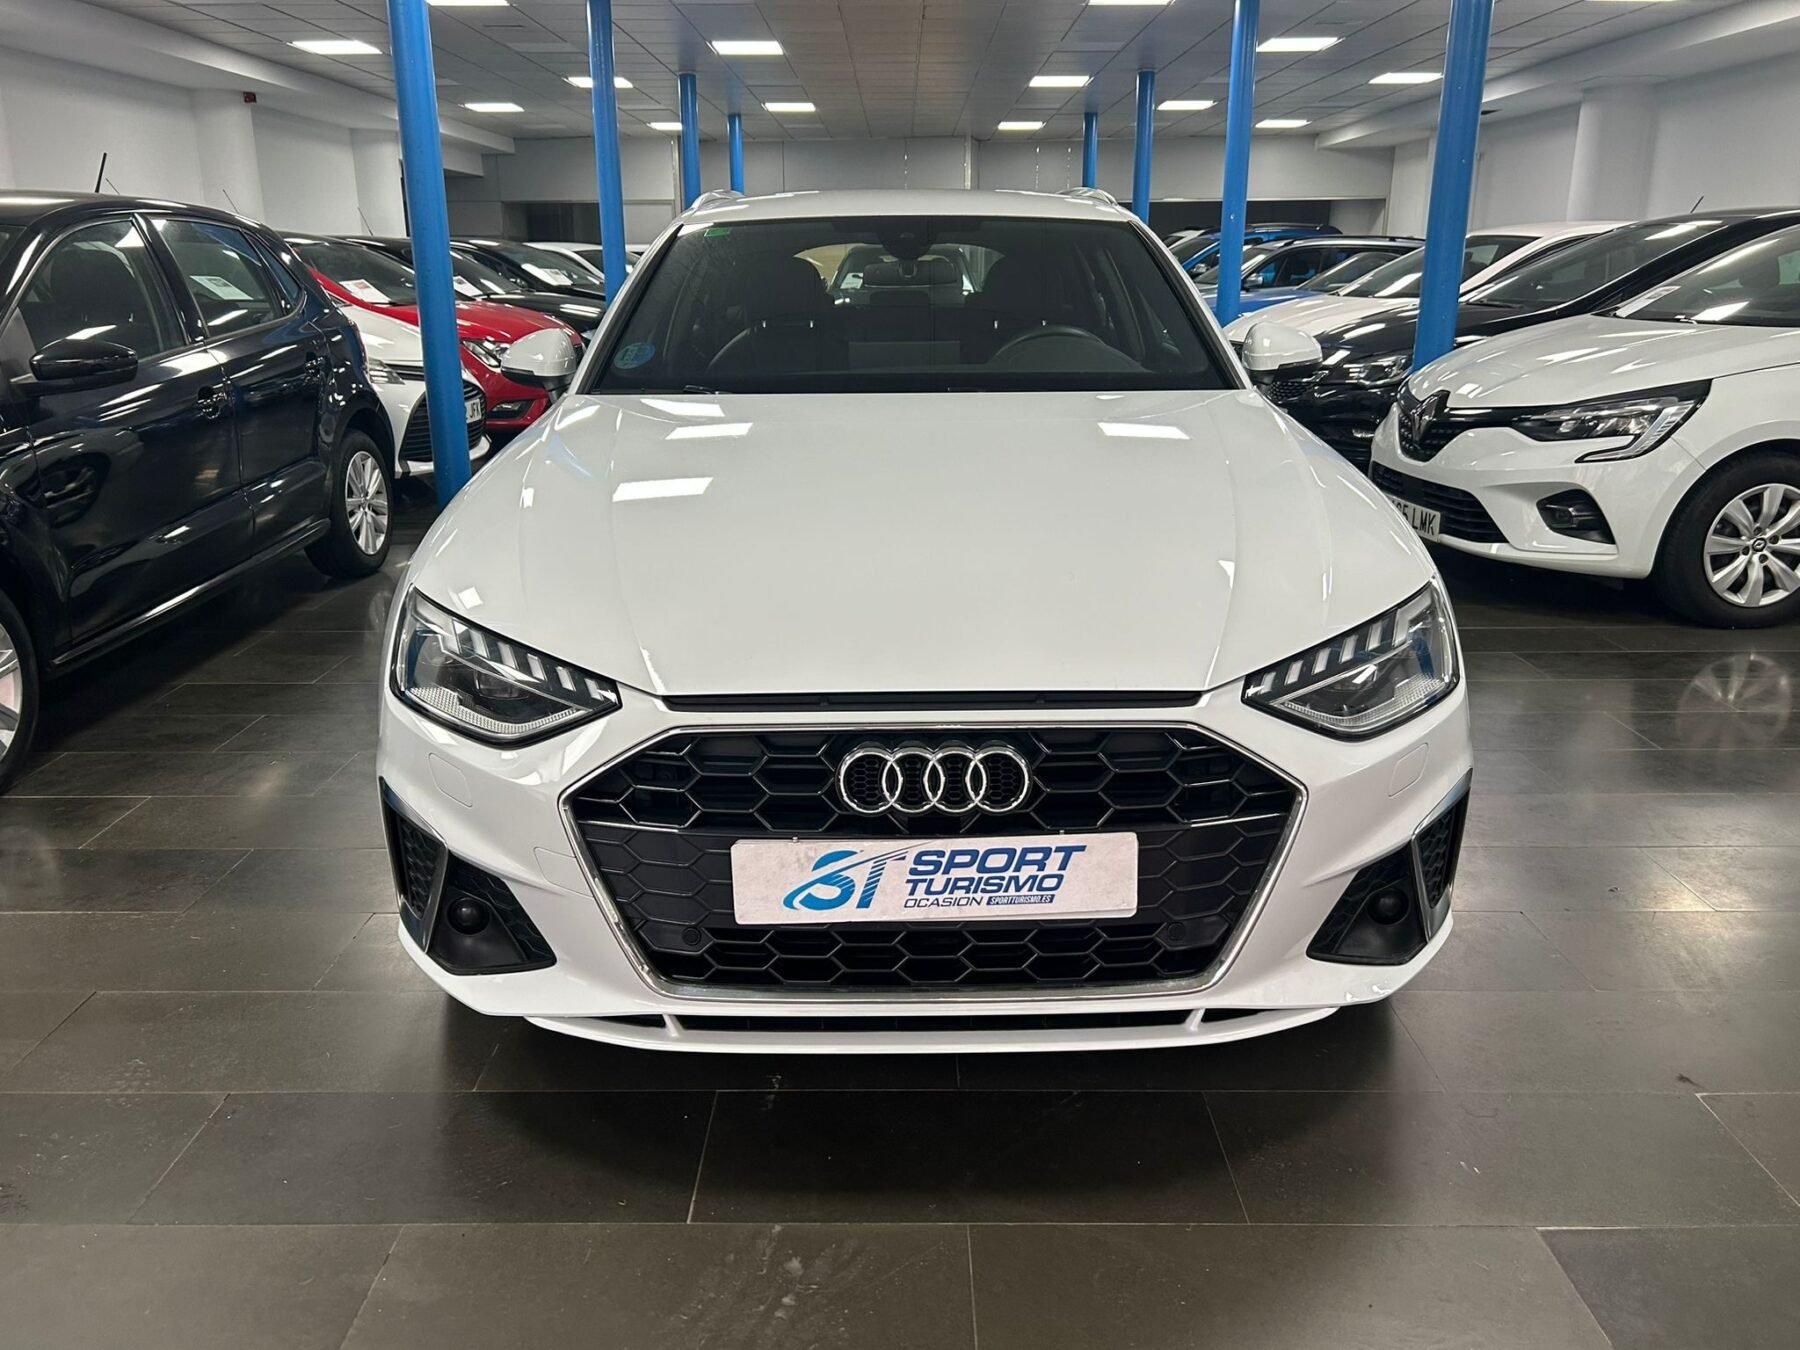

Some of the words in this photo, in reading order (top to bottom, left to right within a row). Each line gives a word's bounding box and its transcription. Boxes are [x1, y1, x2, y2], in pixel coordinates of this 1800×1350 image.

[1412, 507, 1436, 535] LMK
[909, 844, 1087, 876] SPORT
[904, 873, 1066, 897] TURISMO
[904, 896, 984, 909] OCASION
